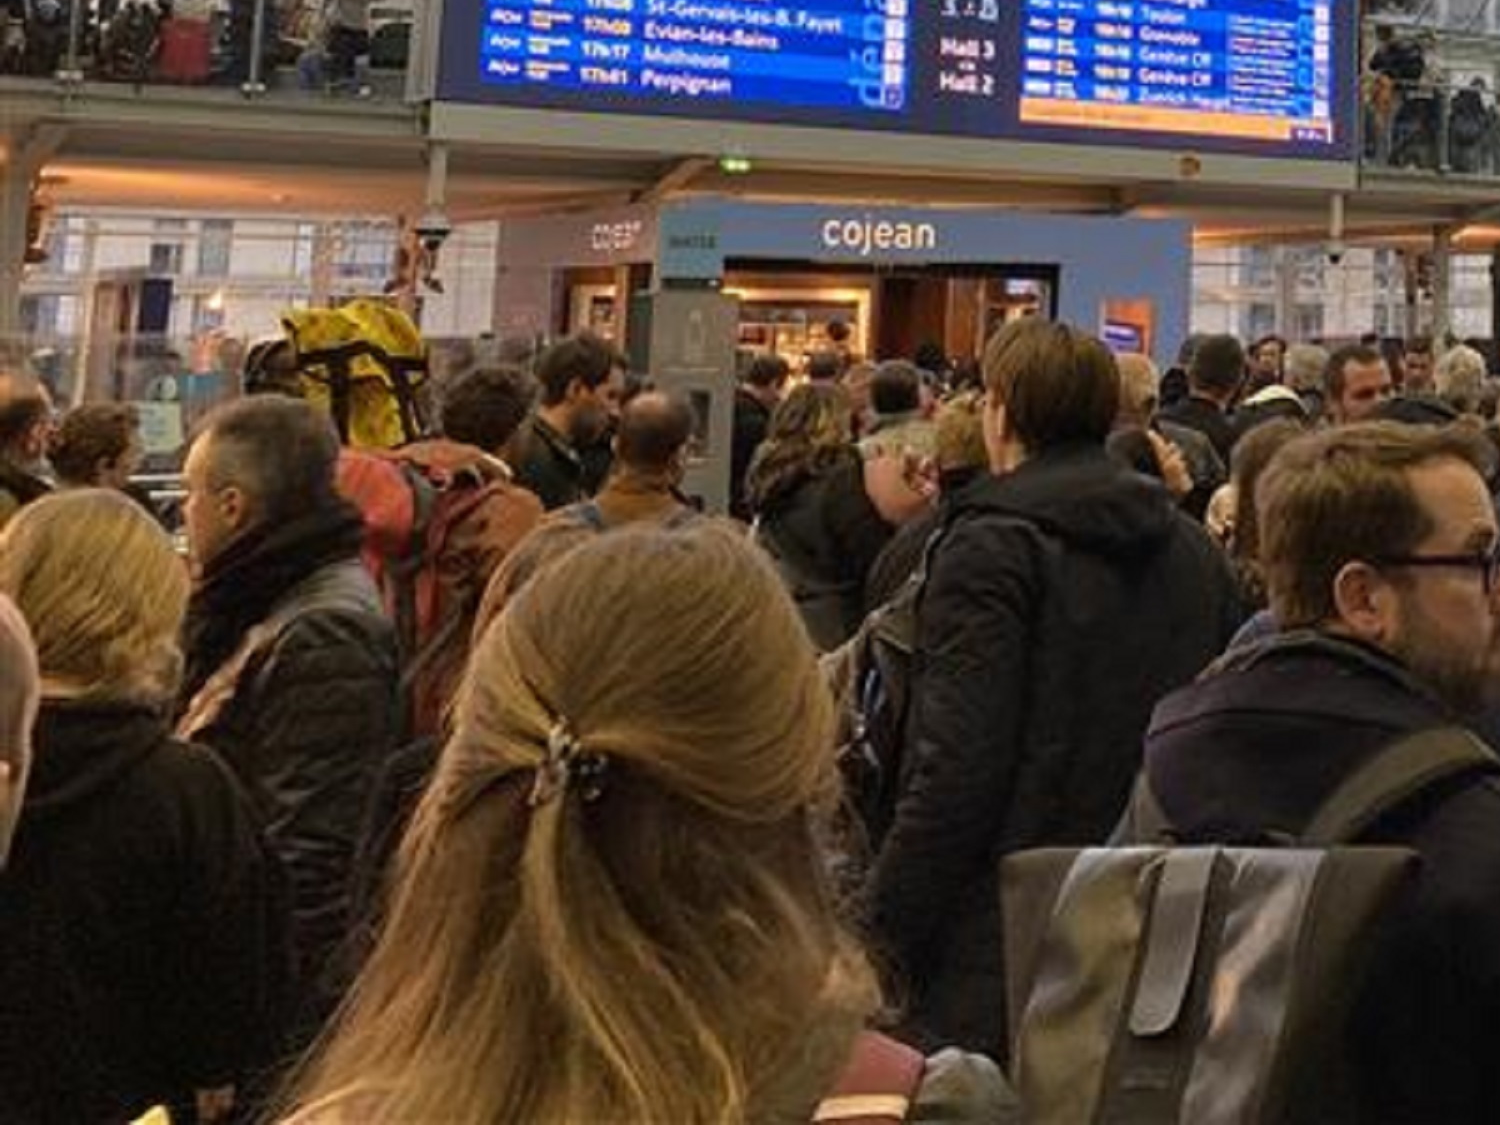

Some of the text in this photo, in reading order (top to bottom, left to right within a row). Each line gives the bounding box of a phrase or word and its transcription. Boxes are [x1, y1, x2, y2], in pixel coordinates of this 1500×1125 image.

[940, 36, 996, 61] Hall 3
[640, 68, 732, 97] Perpignan
[940, 71, 994, 95] Hall 2
[823, 213, 936, 256] cojean
